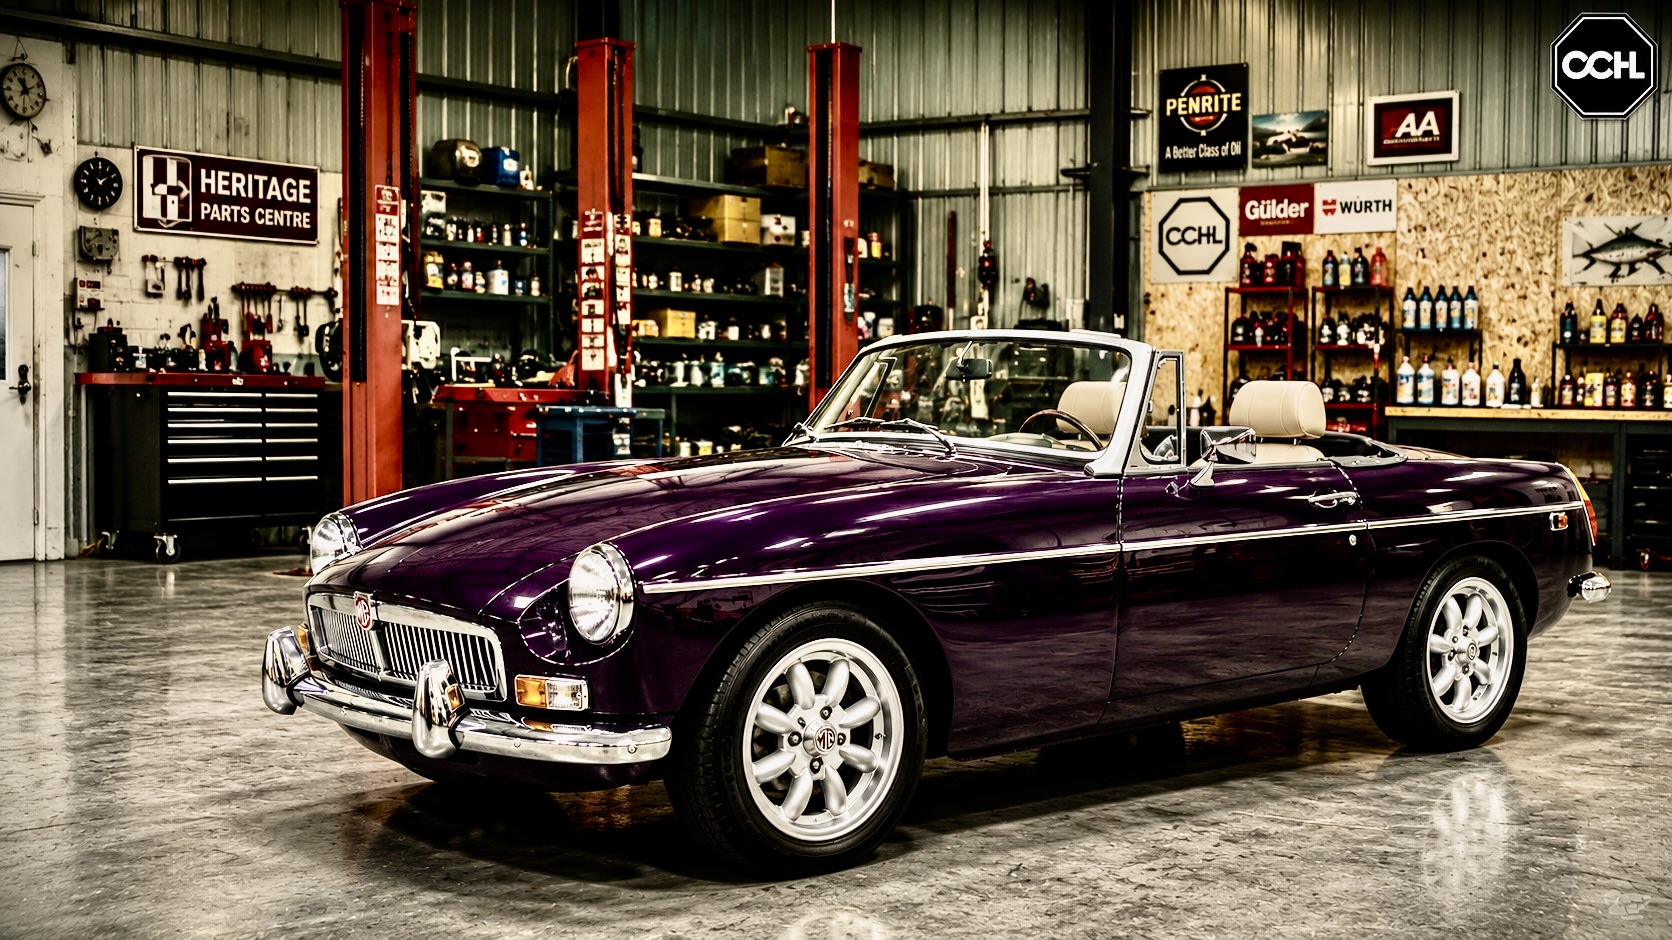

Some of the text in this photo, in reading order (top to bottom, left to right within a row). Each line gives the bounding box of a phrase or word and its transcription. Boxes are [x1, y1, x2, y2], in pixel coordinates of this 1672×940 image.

[1166, 93, 1241, 116] PENRITE
[1395, 111, 1440, 137] AA
[1165, 141, 1241, 159] A Better Class of Oil
[200, 168, 311, 203] HERITAGE
[200, 202, 311, 228] PARTS CENTRE
[1245, 198, 1309, 220] Gülder
[1165, 225, 1223, 246] CCHL
[817, 728, 835, 750] MG
